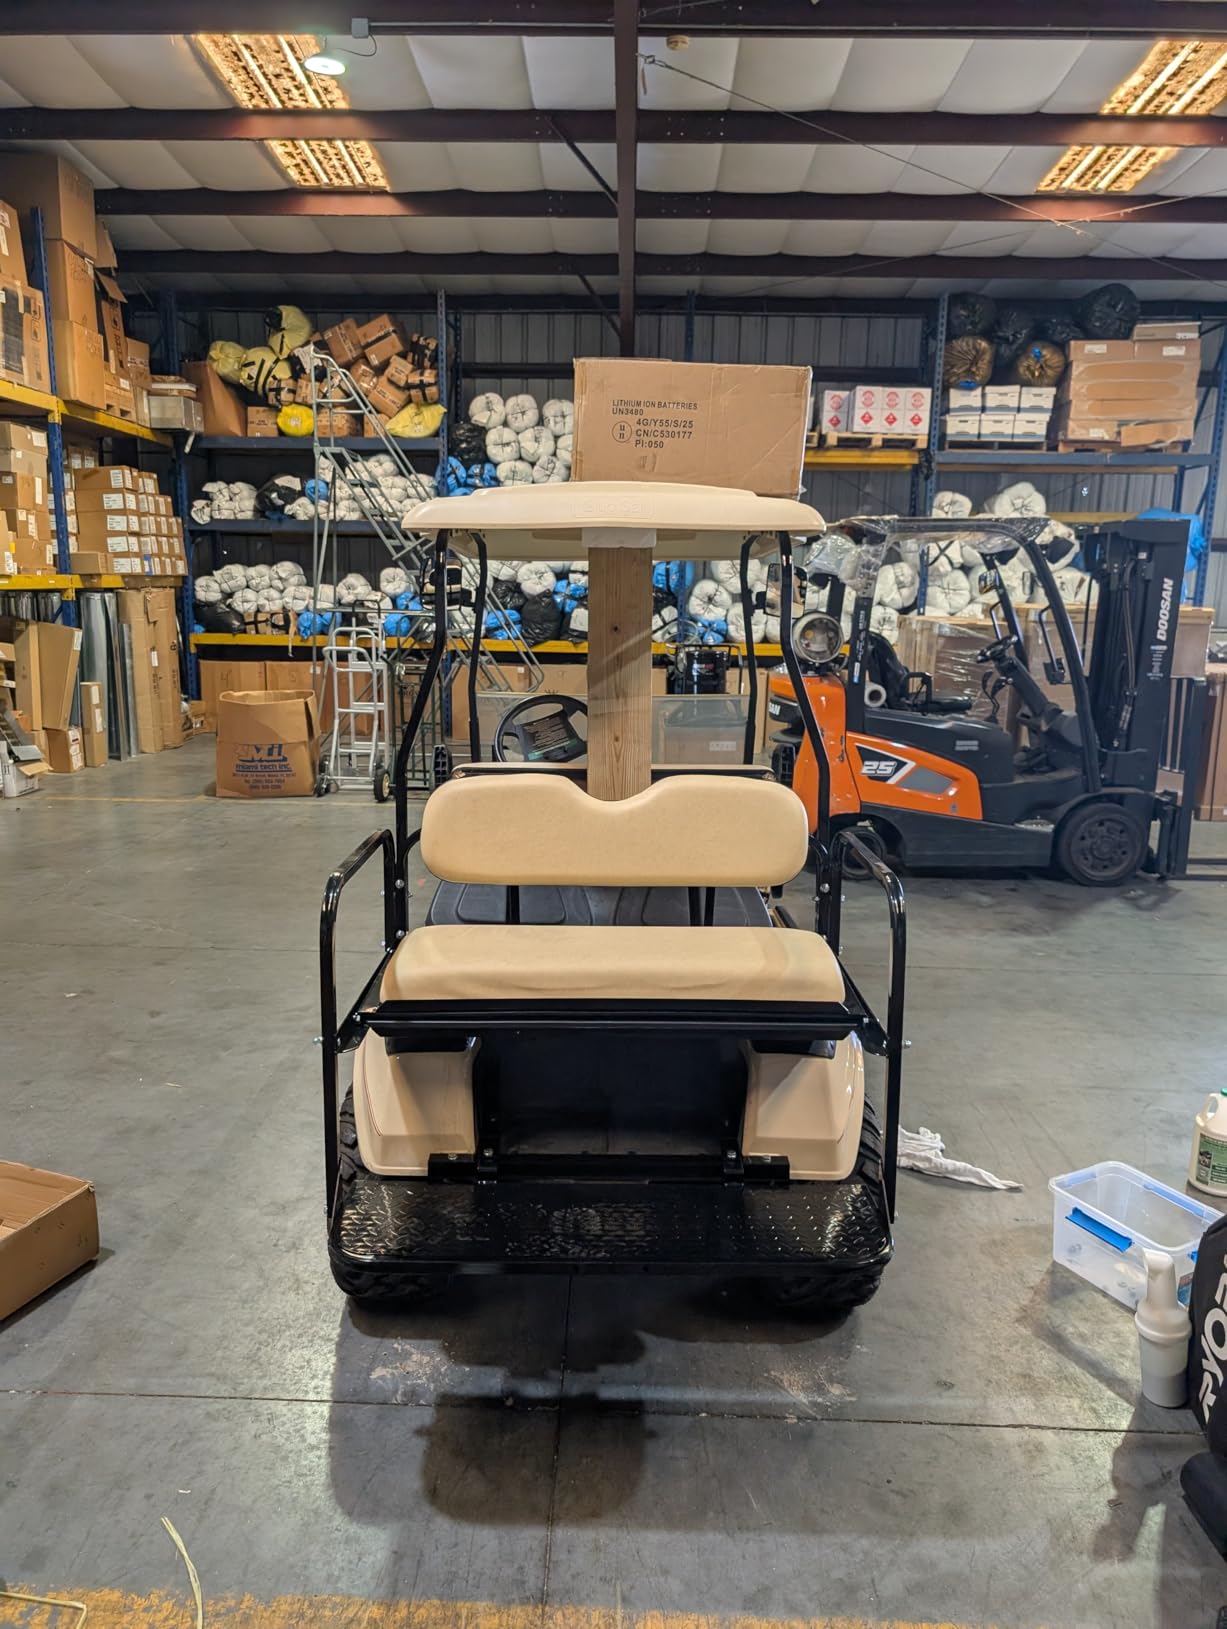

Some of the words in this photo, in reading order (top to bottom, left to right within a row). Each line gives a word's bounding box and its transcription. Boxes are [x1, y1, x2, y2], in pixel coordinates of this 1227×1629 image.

[612, 399, 642, 408] LITHIUM
[643, 400, 656, 409] ION
[657, 401, 698, 410] BATTERIES
[612, 407, 644, 416] UN3480
[636, 418, 694, 429] 4G/Y55/S/25
[635, 429, 693, 440] CN/C530177
[634, 439, 664, 449] PI:050
[1156, 577, 1174, 642] DOOSAN
[861, 760, 897, 776] 25
[1199, 1254, 1227, 1425] RYO
